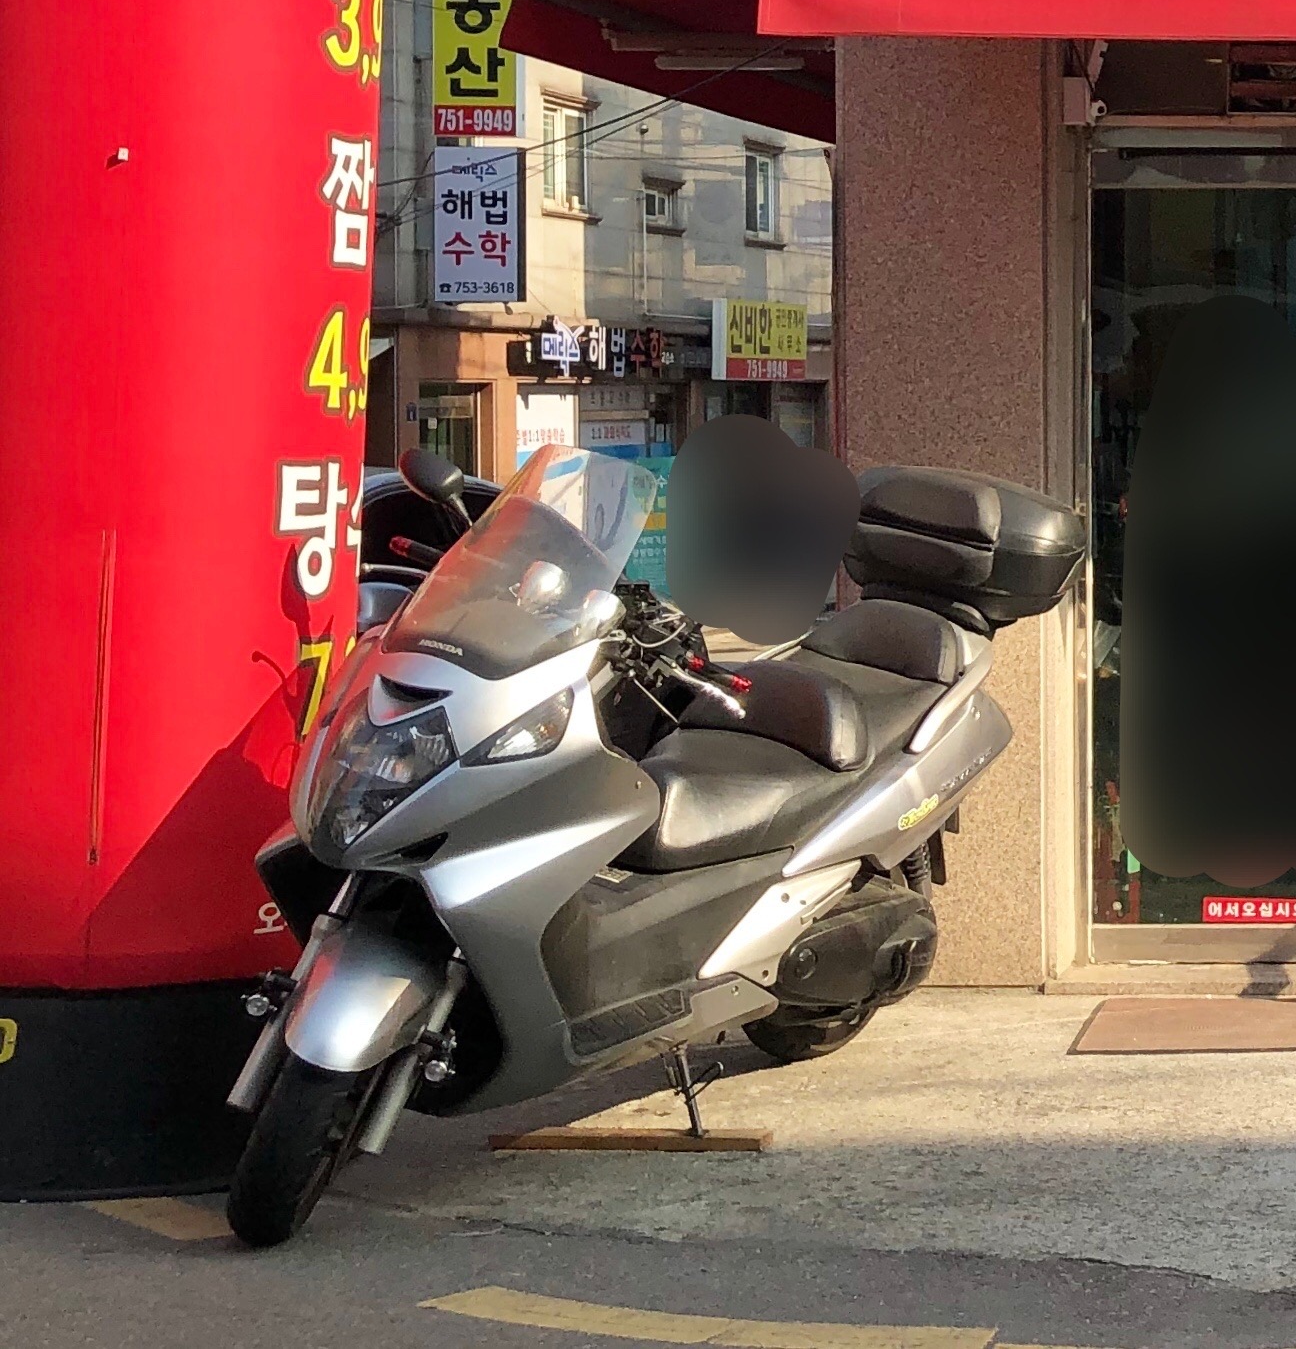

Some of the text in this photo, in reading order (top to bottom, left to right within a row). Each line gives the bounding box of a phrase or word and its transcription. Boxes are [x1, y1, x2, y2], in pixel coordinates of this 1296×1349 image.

[437, 108, 513, 132] 751-9949
[441, 189, 508, 225] 해법
[441, 230, 512, 267] 수학
[455, 281, 515, 294] 753-3618
[730, 304, 773, 355] 신비한
[589, 325, 667, 378] 해법수학
[747, 360, 788, 378] 751-9949
[419, 639, 463, 656] HONDA
